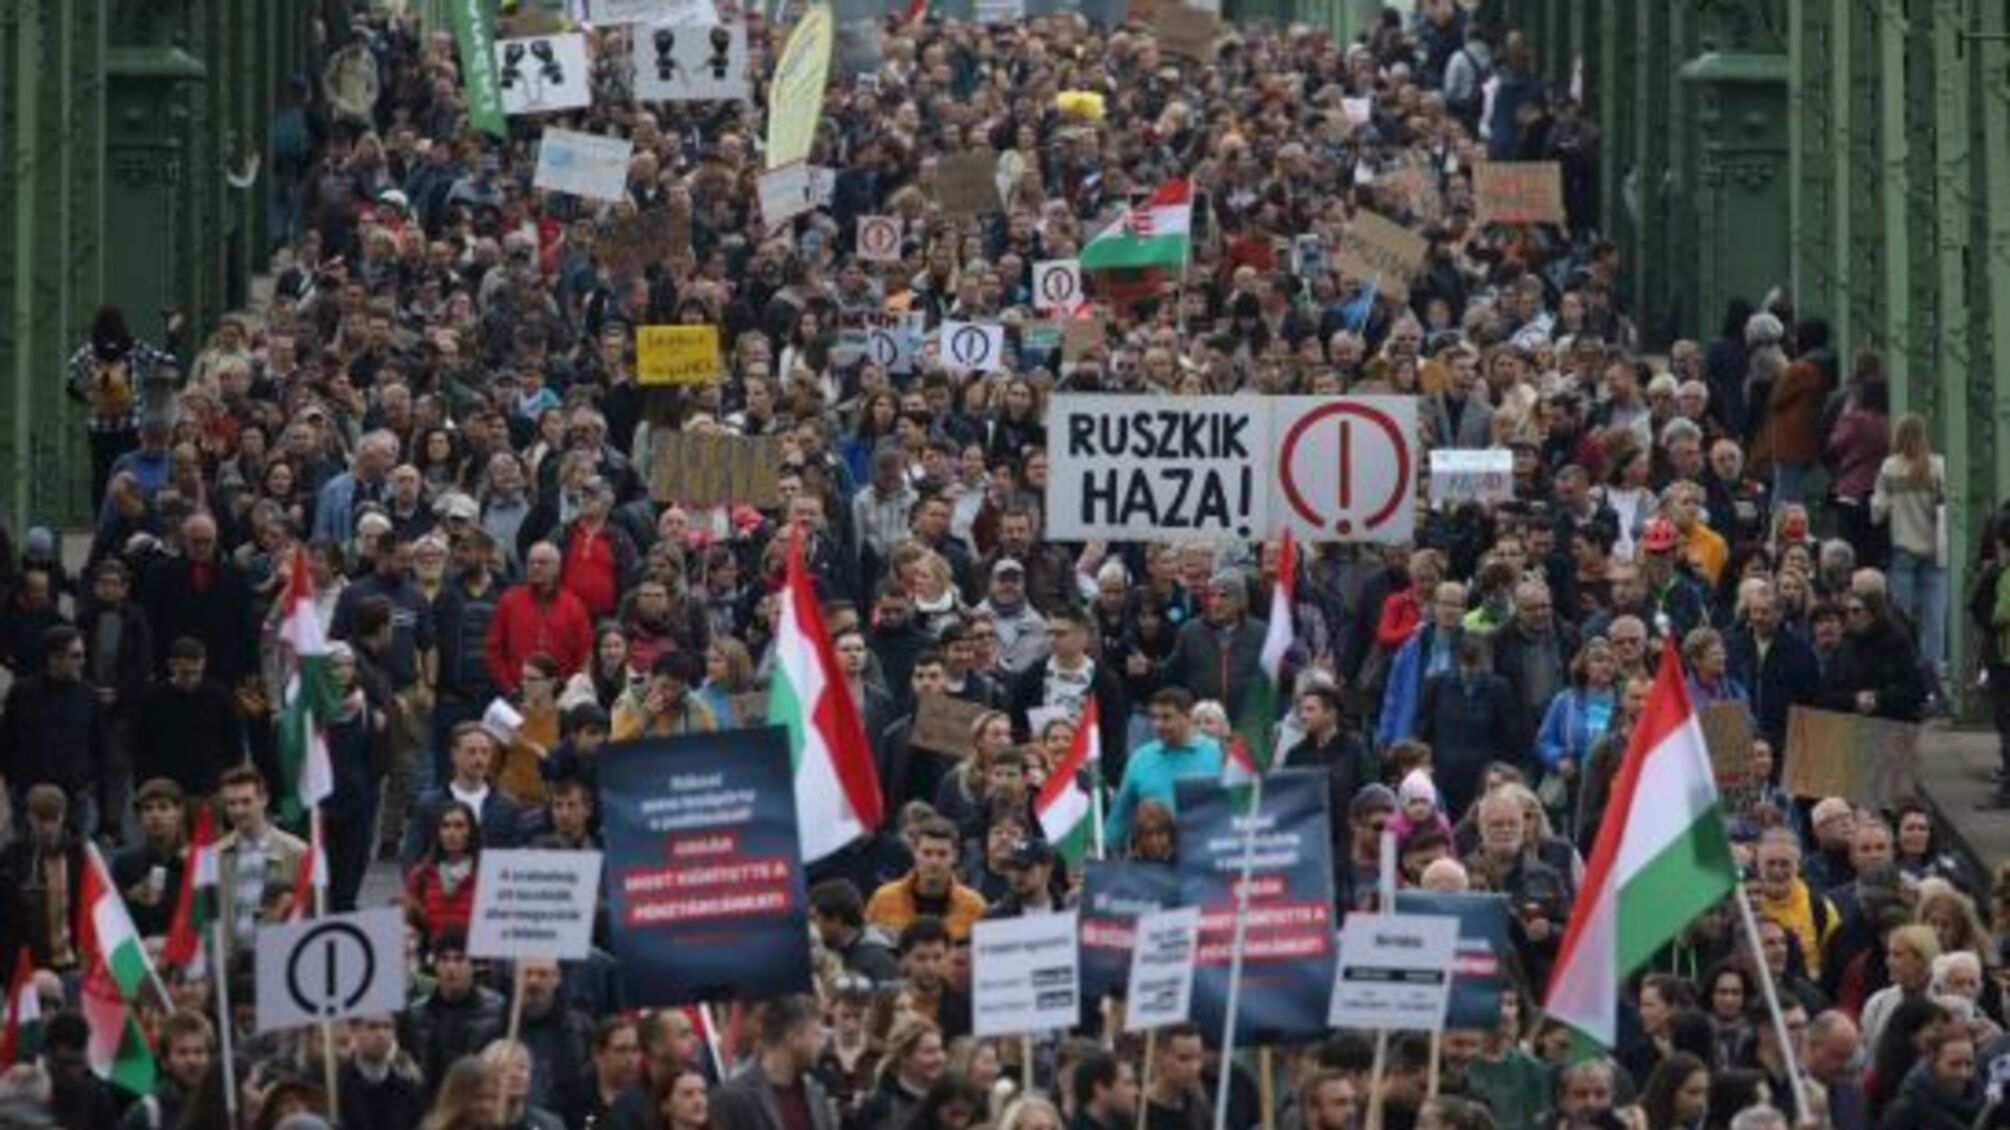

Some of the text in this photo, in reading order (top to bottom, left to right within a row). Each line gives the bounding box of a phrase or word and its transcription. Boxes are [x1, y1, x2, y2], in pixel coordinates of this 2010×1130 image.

[1068, 410, 1249, 459] RUSZKIK
[1080, 464, 1252, 538] HAZA!
[773, 859, 788, 878] A
